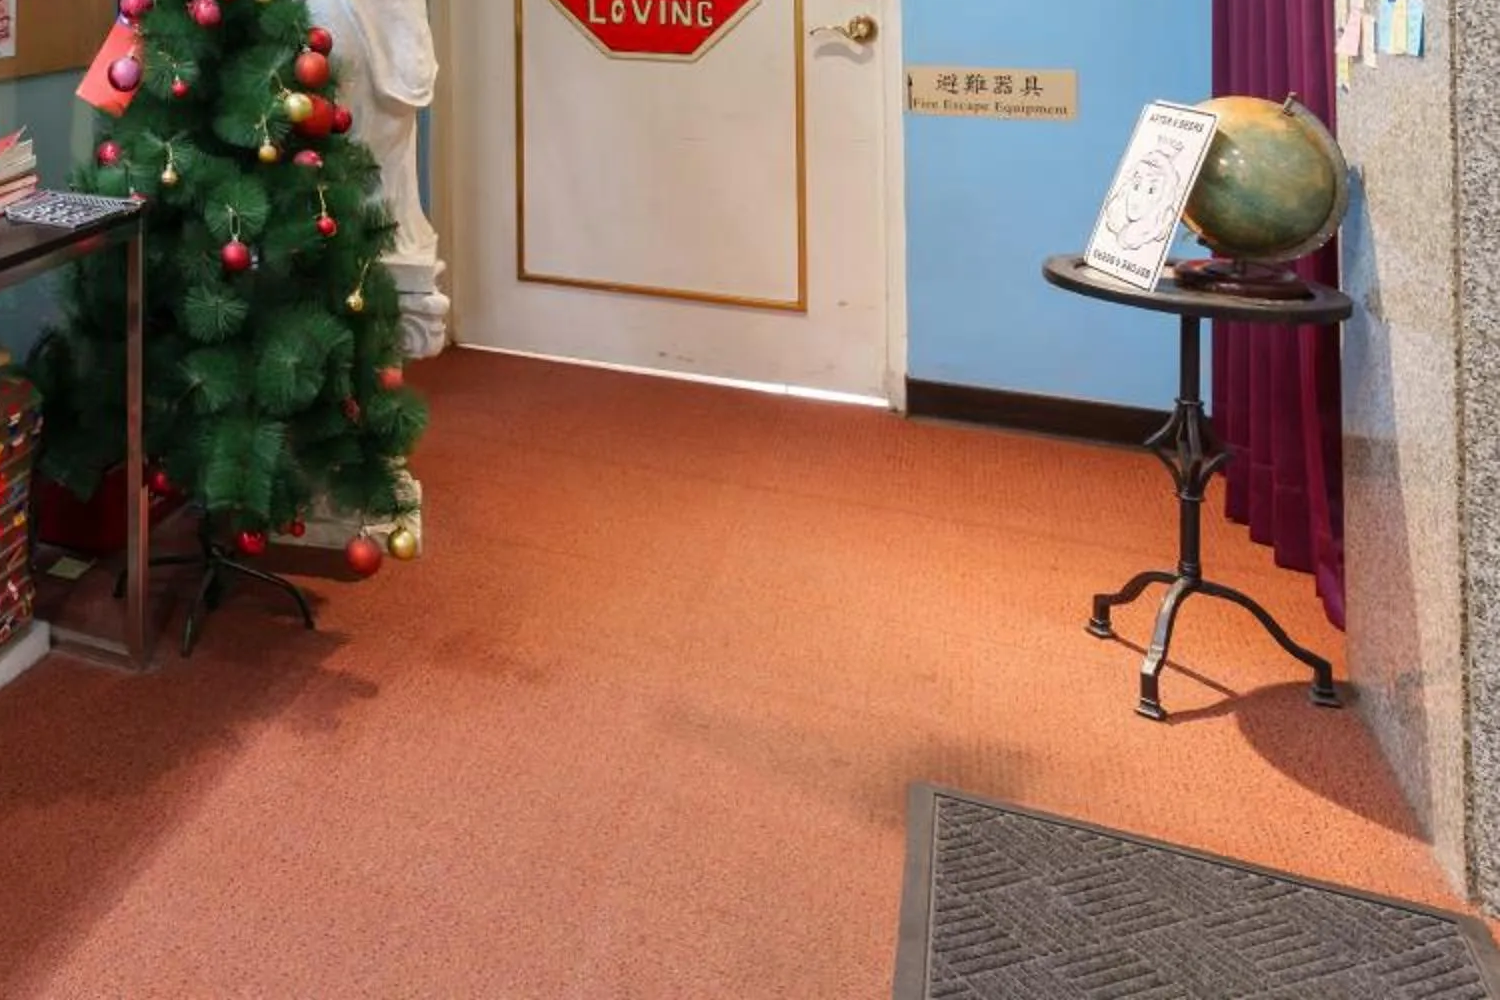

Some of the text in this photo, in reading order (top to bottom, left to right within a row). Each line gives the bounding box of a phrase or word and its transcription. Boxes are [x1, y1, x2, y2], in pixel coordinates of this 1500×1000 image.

[935, 72, 1044, 97] 避難器具
[913, 97, 1068, 116] Fire Escape Equipment
